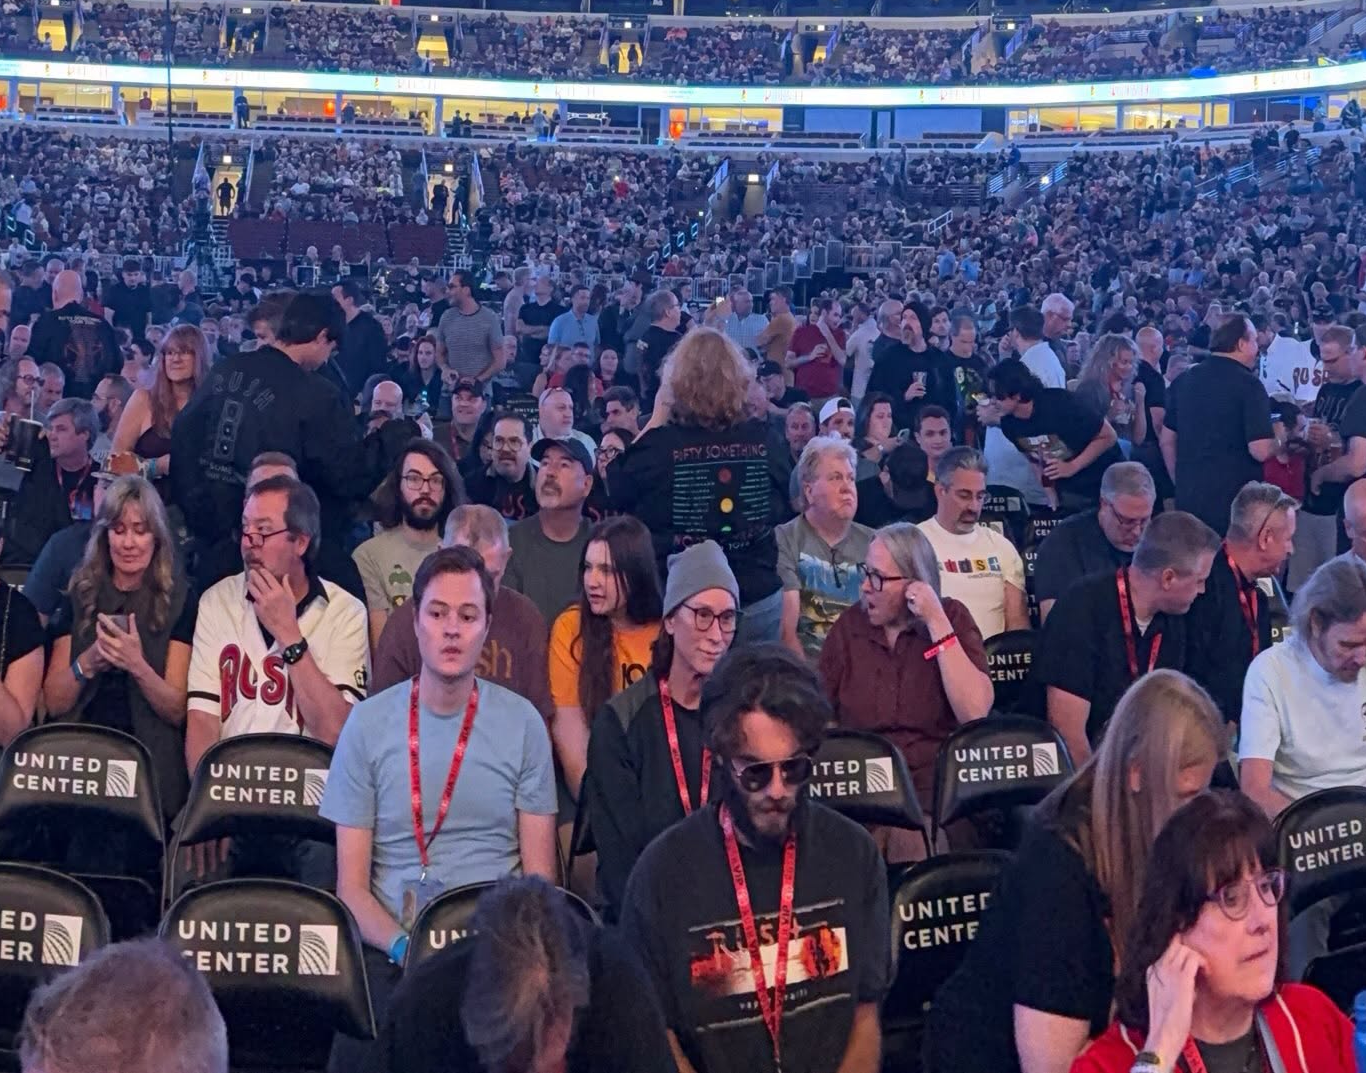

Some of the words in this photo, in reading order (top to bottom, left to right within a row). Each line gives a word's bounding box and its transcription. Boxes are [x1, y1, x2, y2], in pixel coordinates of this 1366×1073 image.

[672, 447, 702, 461] FIFTY
[706, 443, 768, 459] SOMETHING
[14, 752, 102, 773] UNITED
[954, 744, 1028, 763] UNITED
[210, 763, 299, 783] UNITED
[957, 762, 1029, 782] CENTER
[13, 774, 99, 796] CENTER
[209, 785, 297, 806] CENTER
[1288, 819, 1363, 849] UNITED
[1293, 842, 1365, 873] CENTER
[178, 920, 292, 944] UNITED
